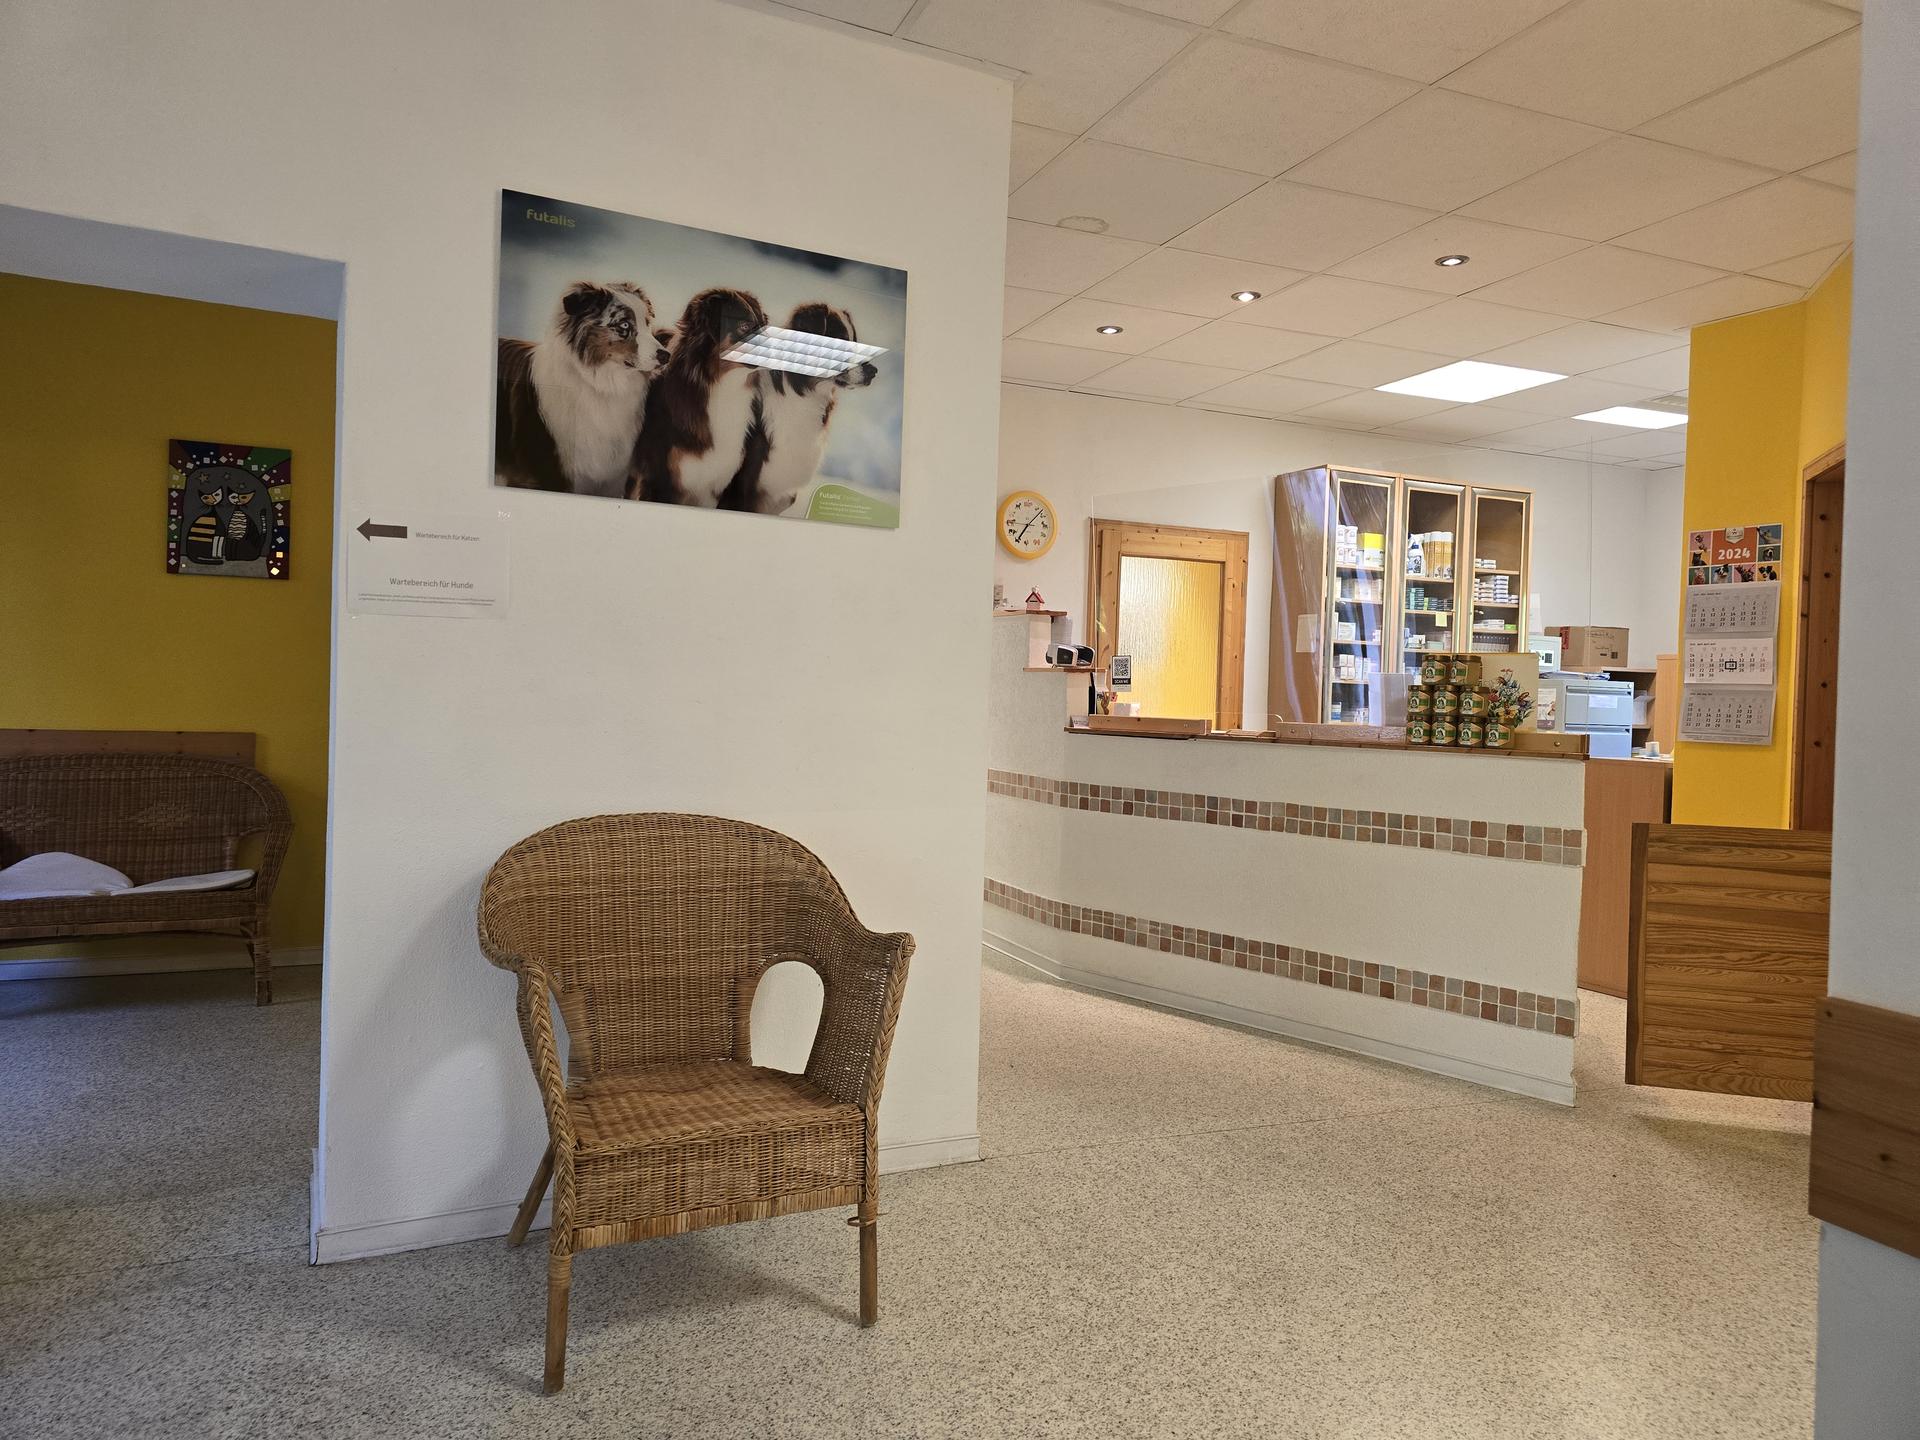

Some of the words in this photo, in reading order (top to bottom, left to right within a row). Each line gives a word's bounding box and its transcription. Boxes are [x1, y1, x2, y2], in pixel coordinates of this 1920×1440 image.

[526, 208, 576, 228] futalis
[415, 532, 452, 540] Wartebereich
[1718, 547, 1751, 560] 2024
[389, 577, 438, 587] Wartebereich
[440, 580, 450, 588] für
[451, 580, 474, 589] Hunde
